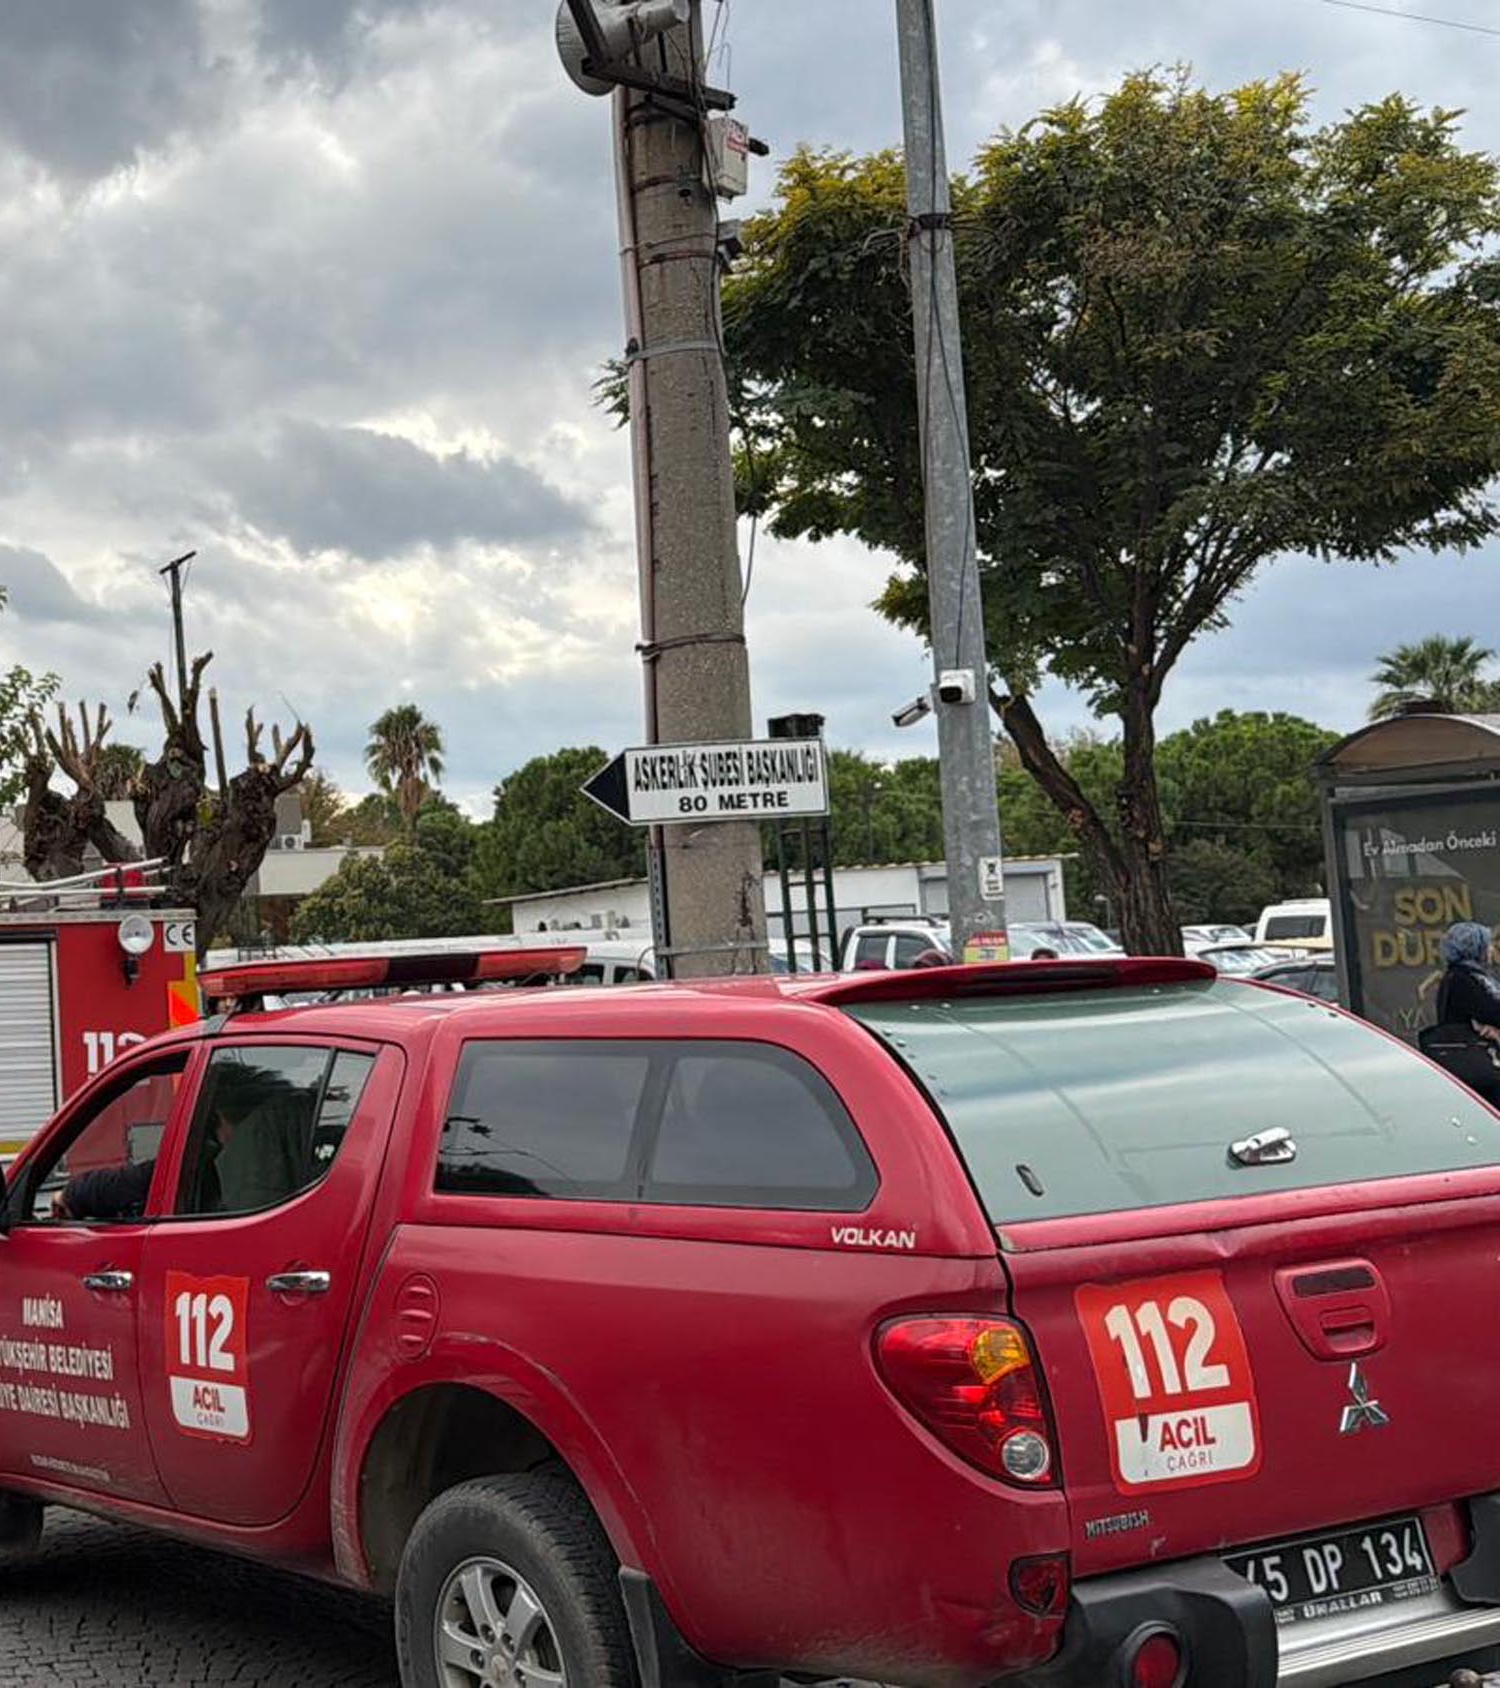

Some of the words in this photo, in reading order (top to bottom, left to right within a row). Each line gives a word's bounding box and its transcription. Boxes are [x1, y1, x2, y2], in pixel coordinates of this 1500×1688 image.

[634, 750, 698, 791] ASKERLİK
[701, 747, 745, 790] ŞUBESİ
[746, 745, 819, 786] BAŞKANLIĞI
[678, 796, 708, 813] 80
[718, 791, 789, 811] METRE
[1446, 830, 1497, 850] Önceki
[1395, 883, 1472, 925] SON
[831, 1227, 916, 1249] VOLKAN
[23, 1293, 64, 1329] MANİSA
[175, 1291, 235, 1372] 112
[48, 1341, 114, 1381] BELEDİYESİ
[1104, 1295, 1231, 1399] 112
[17, 1381, 61, 1418] DAİRESİ
[59, 1391, 131, 1430] BAŞKANLIĞI
[1302, 1543, 1342, 1594] DP
[1361, 1528, 1422, 1580] 134
